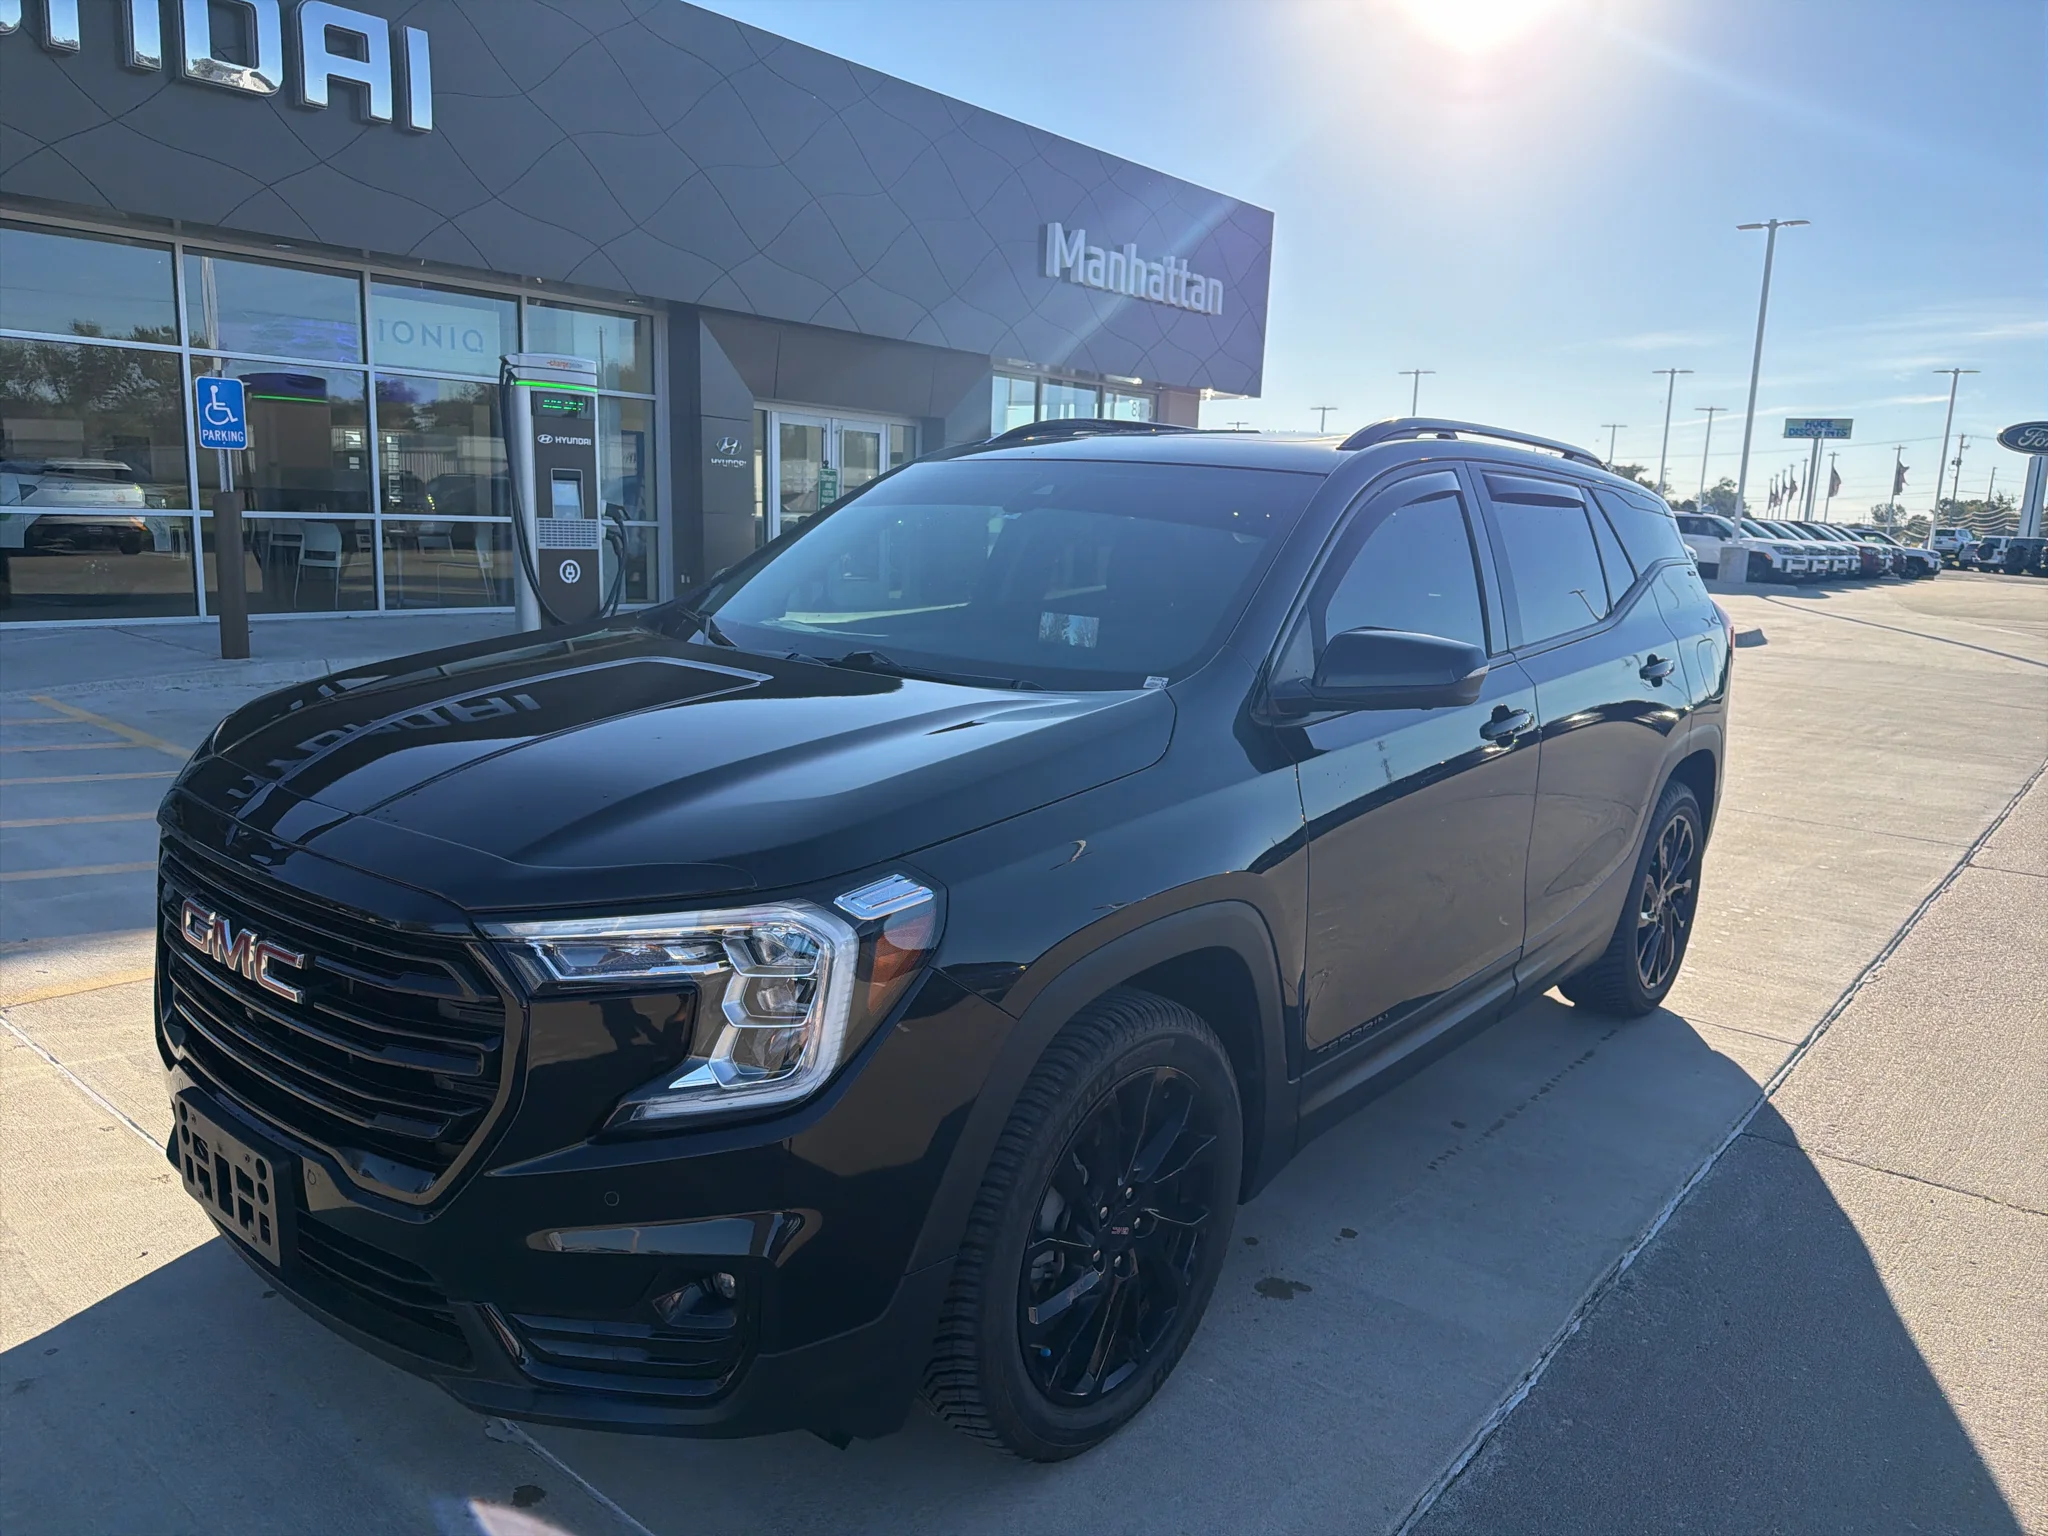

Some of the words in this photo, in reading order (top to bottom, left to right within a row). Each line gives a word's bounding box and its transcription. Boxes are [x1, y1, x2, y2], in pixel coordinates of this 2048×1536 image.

[0, 0, 432, 133] DAI
[1046, 222, 1223, 316] Manhattan
[379, 319, 483, 353] IONIQ
[1804, 420, 1833, 428] HUGE
[202, 430, 244, 442] PARKING
[555, 436, 592, 446] HYUNDAI
[711, 458, 747, 468] HYUNDAI
[181, 898, 304, 1004] GMC
